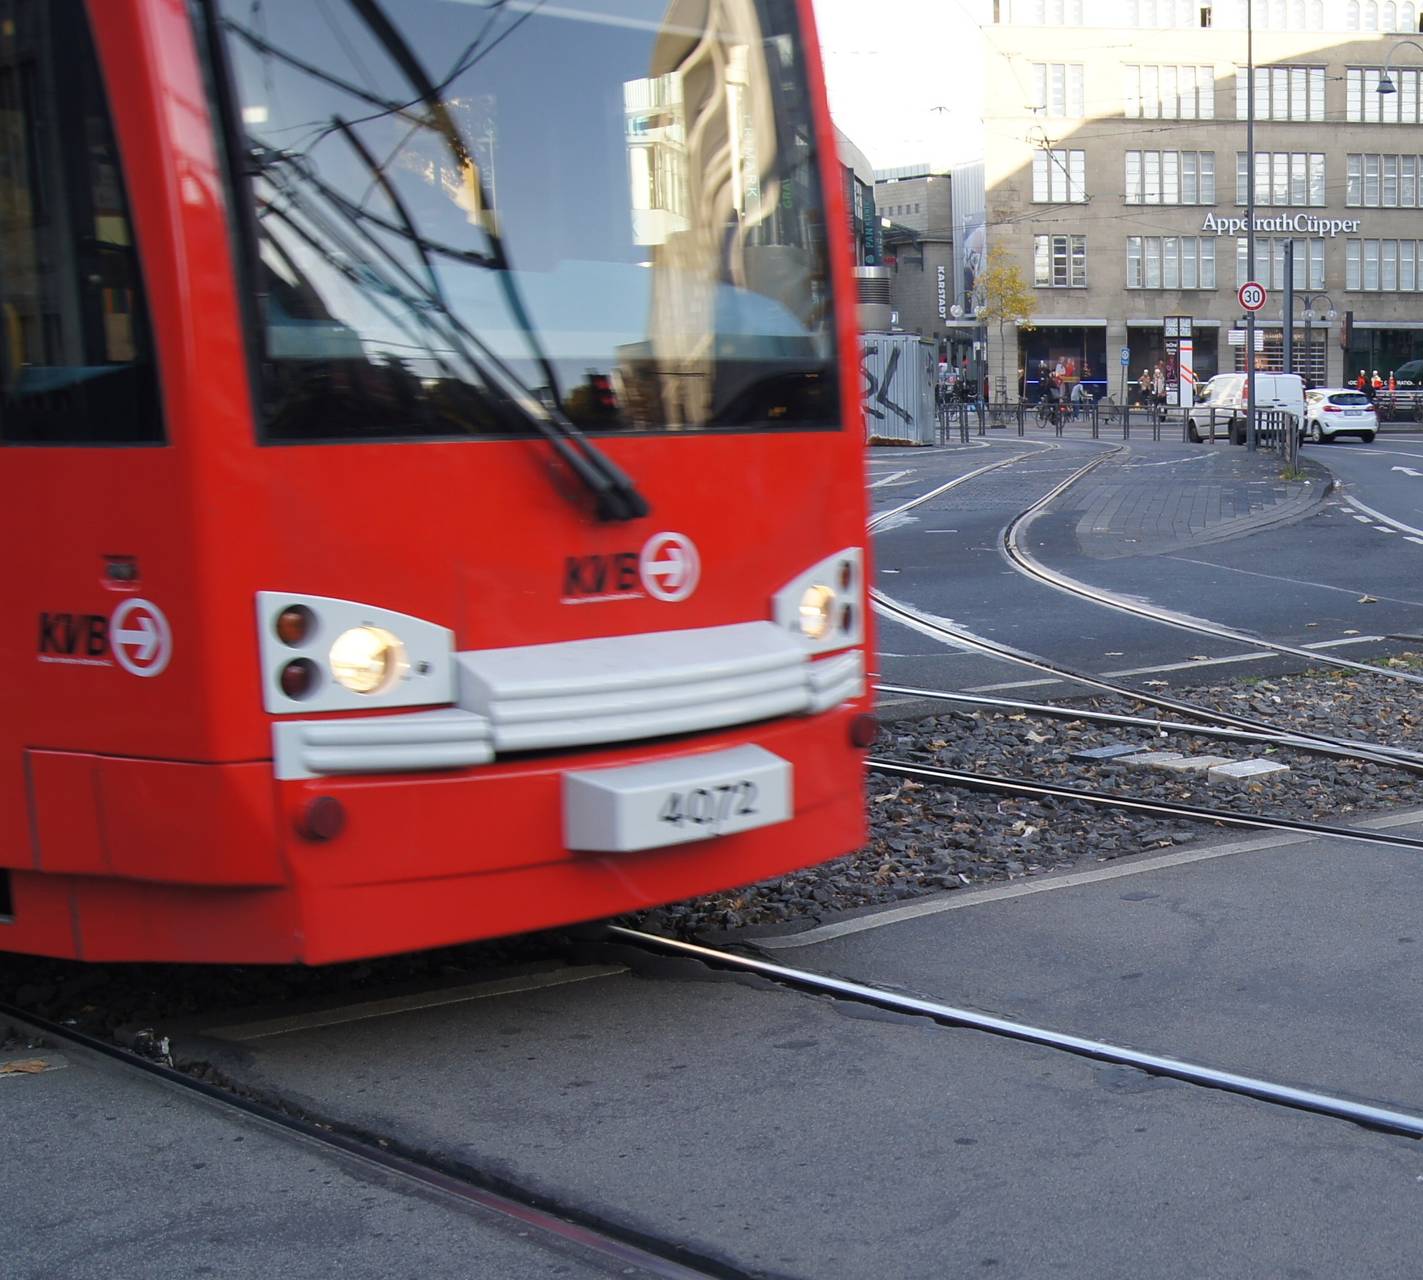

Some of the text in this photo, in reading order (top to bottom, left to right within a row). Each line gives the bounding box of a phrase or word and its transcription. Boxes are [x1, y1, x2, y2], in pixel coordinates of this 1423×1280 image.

[1201, 212, 1361, 238] AppelrathCüpper
[937, 266, 947, 319] KARSTADT
[1244, 290, 1260, 303] 30
[563, 552, 640, 596] KVB
[38, 612, 109, 656] KVB
[657, 780, 758, 828] 4072
